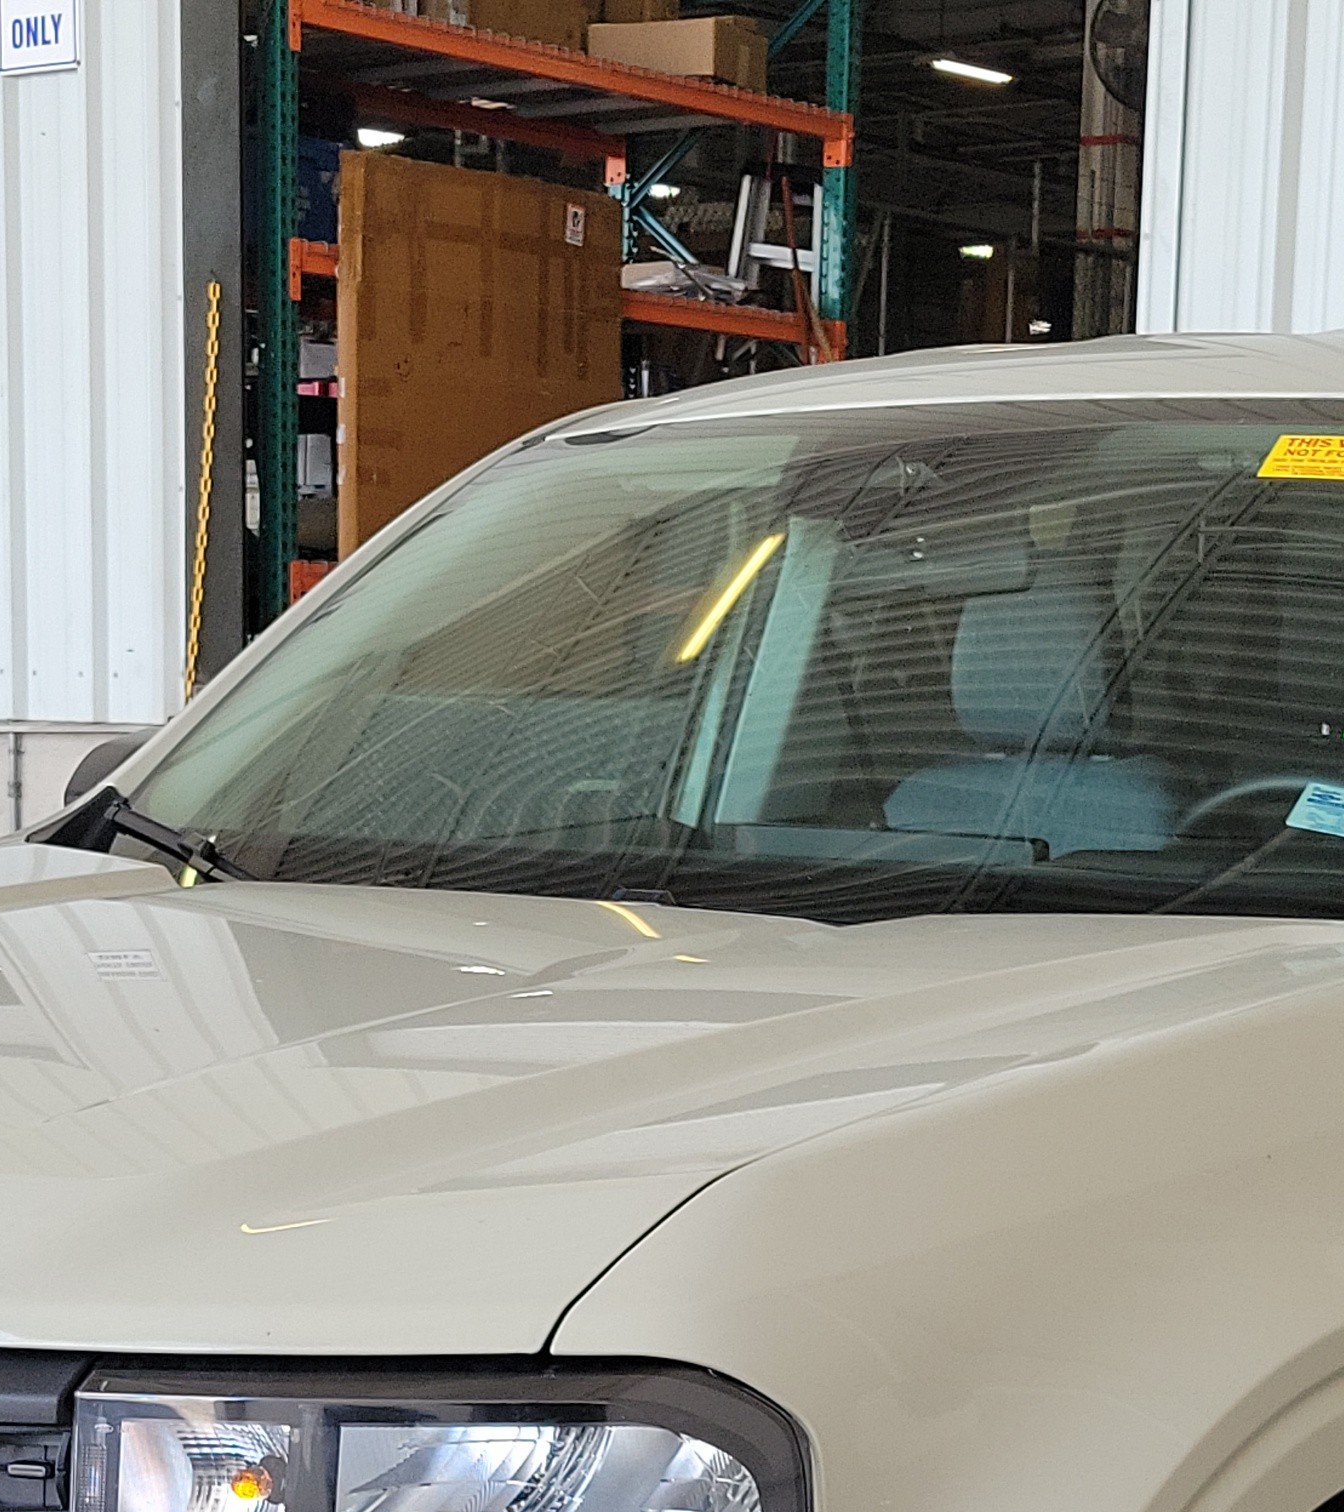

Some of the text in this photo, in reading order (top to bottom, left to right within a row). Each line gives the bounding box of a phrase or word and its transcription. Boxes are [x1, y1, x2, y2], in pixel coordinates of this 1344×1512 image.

[11, 13, 63, 50] ONLY
[1286, 437, 1332, 449] THIS
[1283, 449, 1317, 457] NOT
